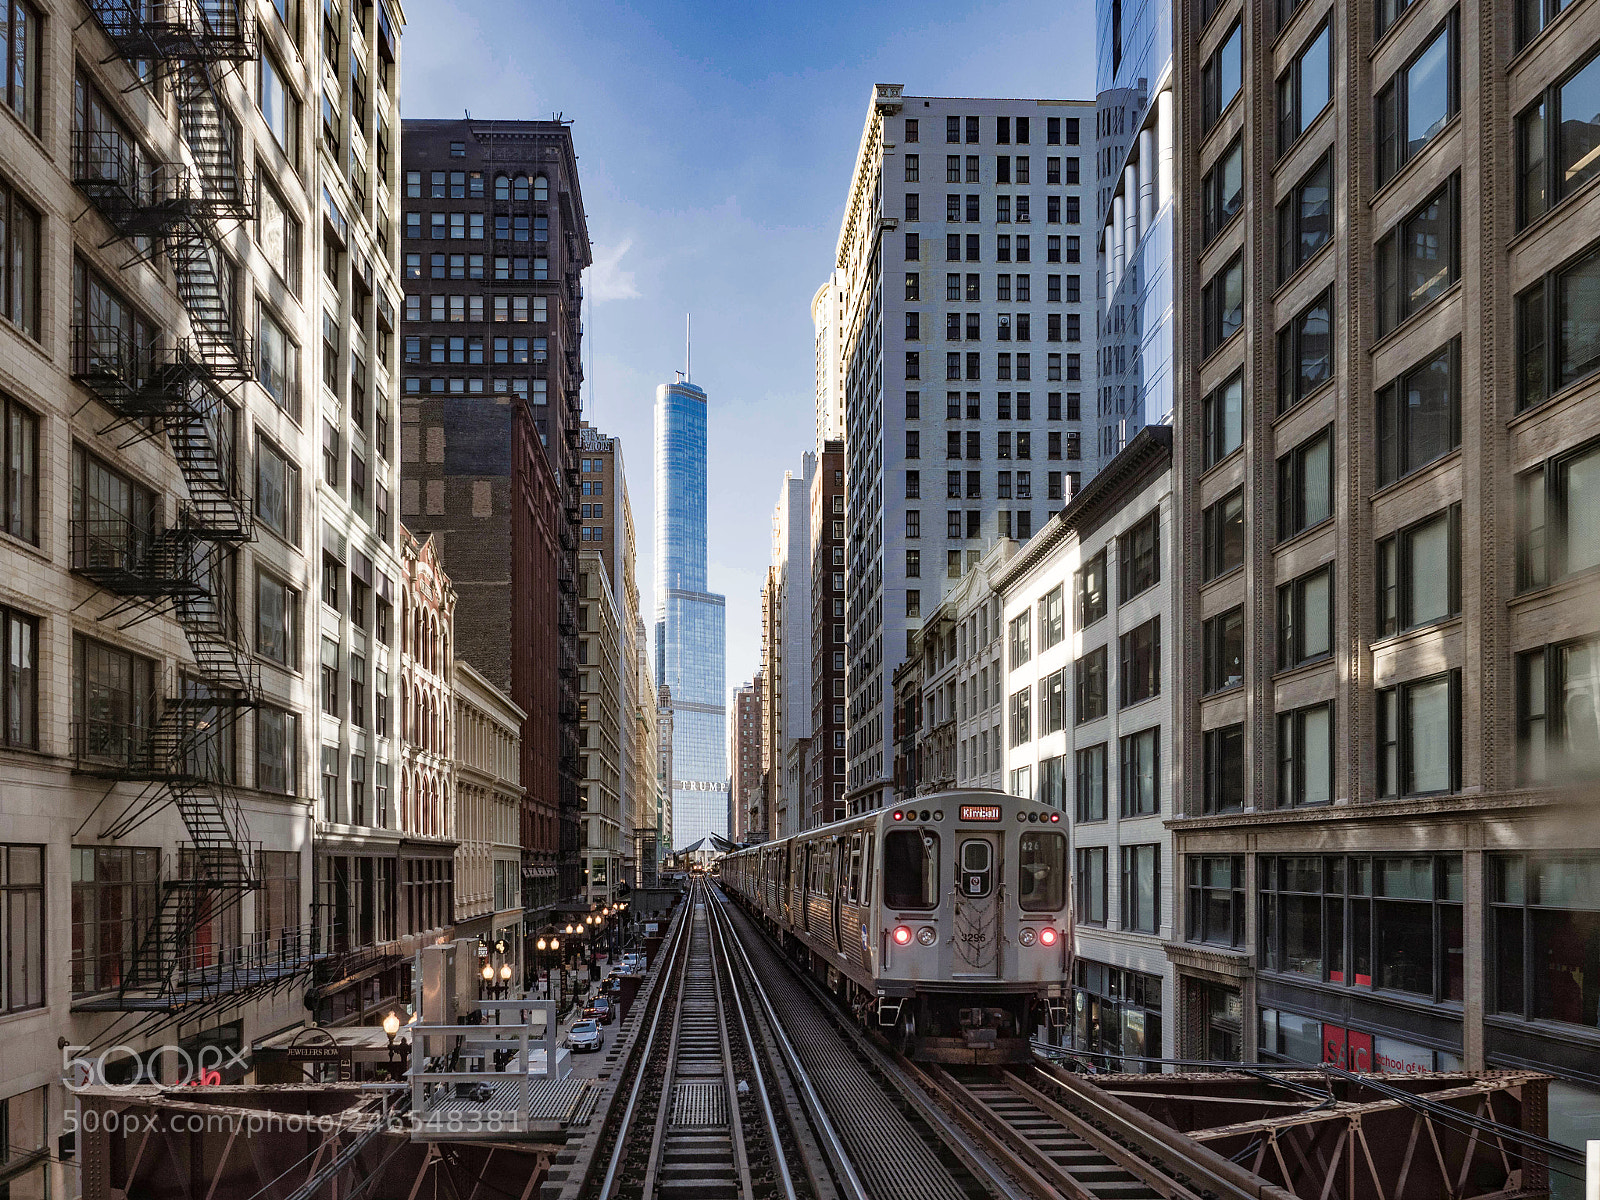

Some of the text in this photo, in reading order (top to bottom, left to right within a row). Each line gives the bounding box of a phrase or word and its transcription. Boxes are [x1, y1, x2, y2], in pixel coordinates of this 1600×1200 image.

[681, 780, 726, 792] TRUMP
[963, 808, 999, 818] Kimball
[1021, 841, 1039, 851] 426
[961, 933, 986, 942] 3296
[288, 1048, 339, 1056] JEWELERS ROW
[1327, 1039, 1368, 1073] SAIC
[1376, 1052, 1404, 1071] School
